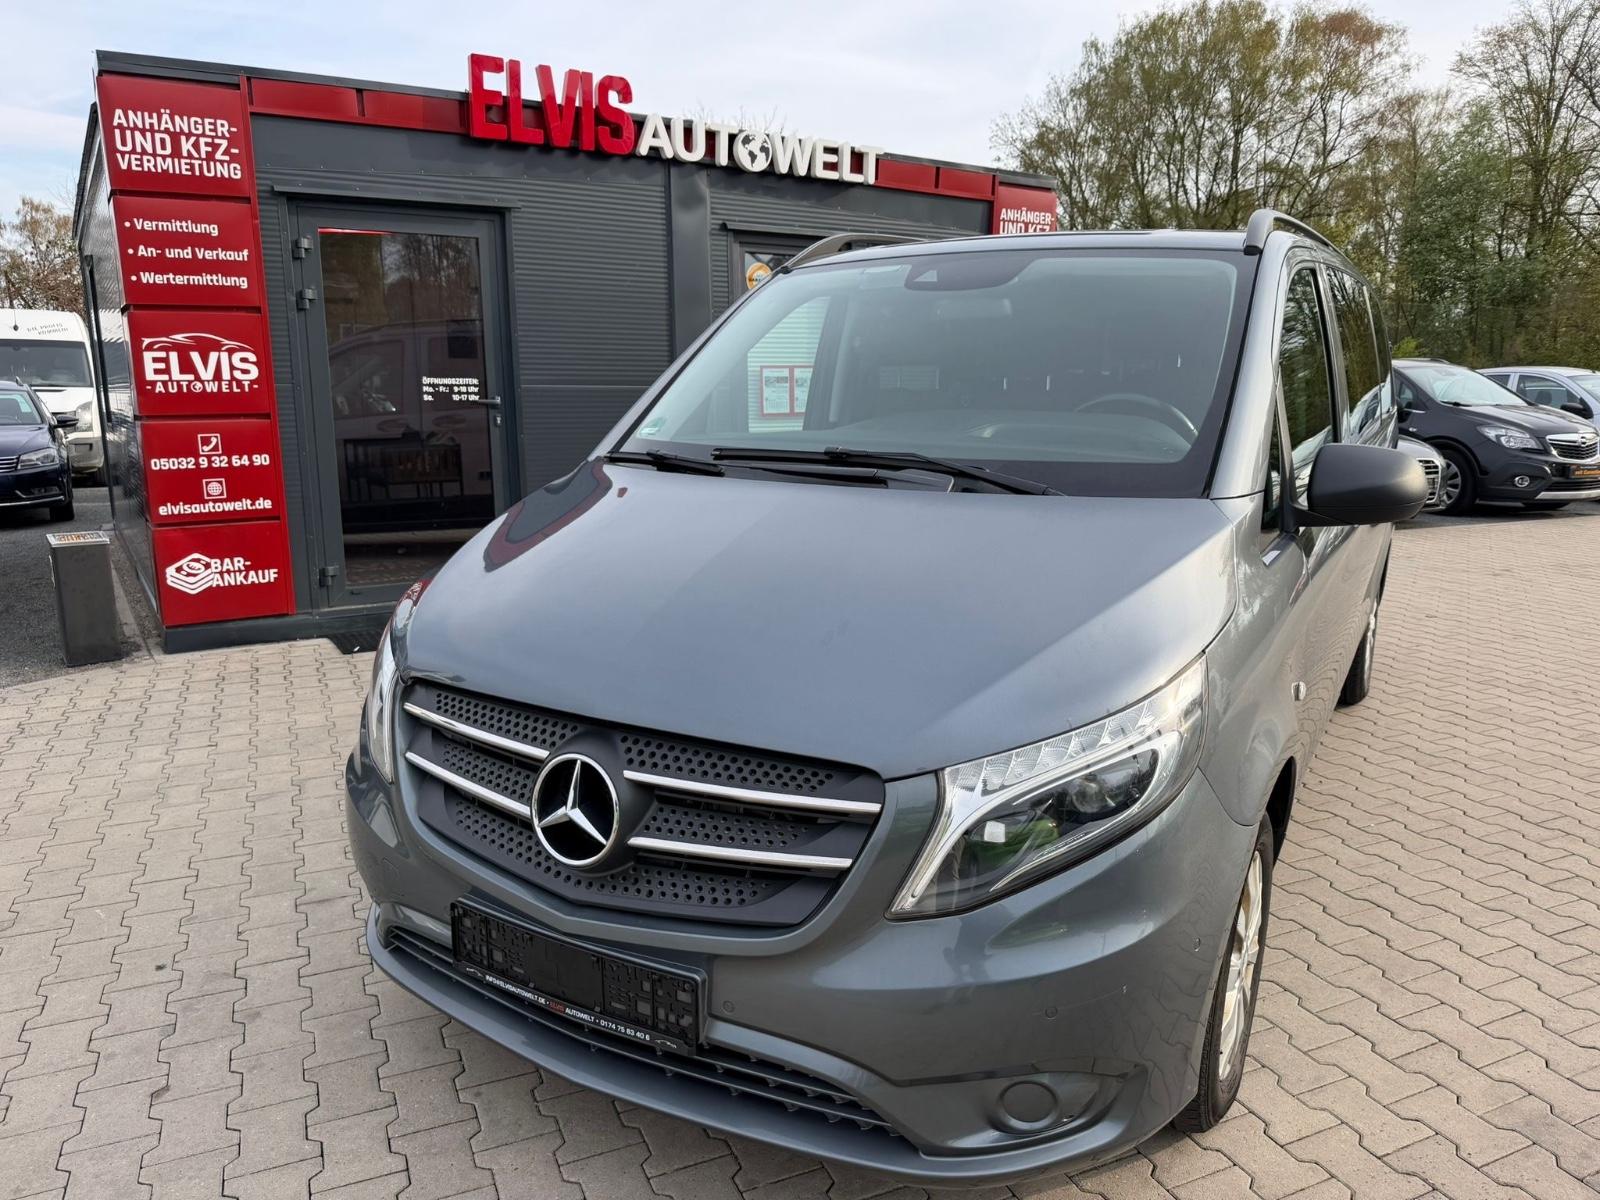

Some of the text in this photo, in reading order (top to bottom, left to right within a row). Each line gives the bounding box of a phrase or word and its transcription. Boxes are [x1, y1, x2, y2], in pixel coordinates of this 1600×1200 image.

[467, 53, 636, 156] ELVIS
[113, 108, 237, 138] ANHÄNGER-
[114, 128, 239, 161] UND KFZ-
[116, 153, 242, 180] VERMIETUNG
[1000, 206, 1055, 225] ANHÄNGER-
[133, 218, 219, 236] Vermittlung
[1000, 221, 1025, 235] UND
[137, 245, 248, 261] An- und Verkauf
[140, 271, 248, 289] Wertermittlung
[142, 351, 259, 381] ELVIS
[150, 454, 270, 470] 05032 9 32 64 90
[158, 497, 272, 516] elvisautowelt.de
[210, 556, 251, 573] BAR-
[212, 568, 278, 587] ANKAUF
[565, 1007, 595, 1022] AUTOWELT
[600, 1019, 616, 1030] 0174
